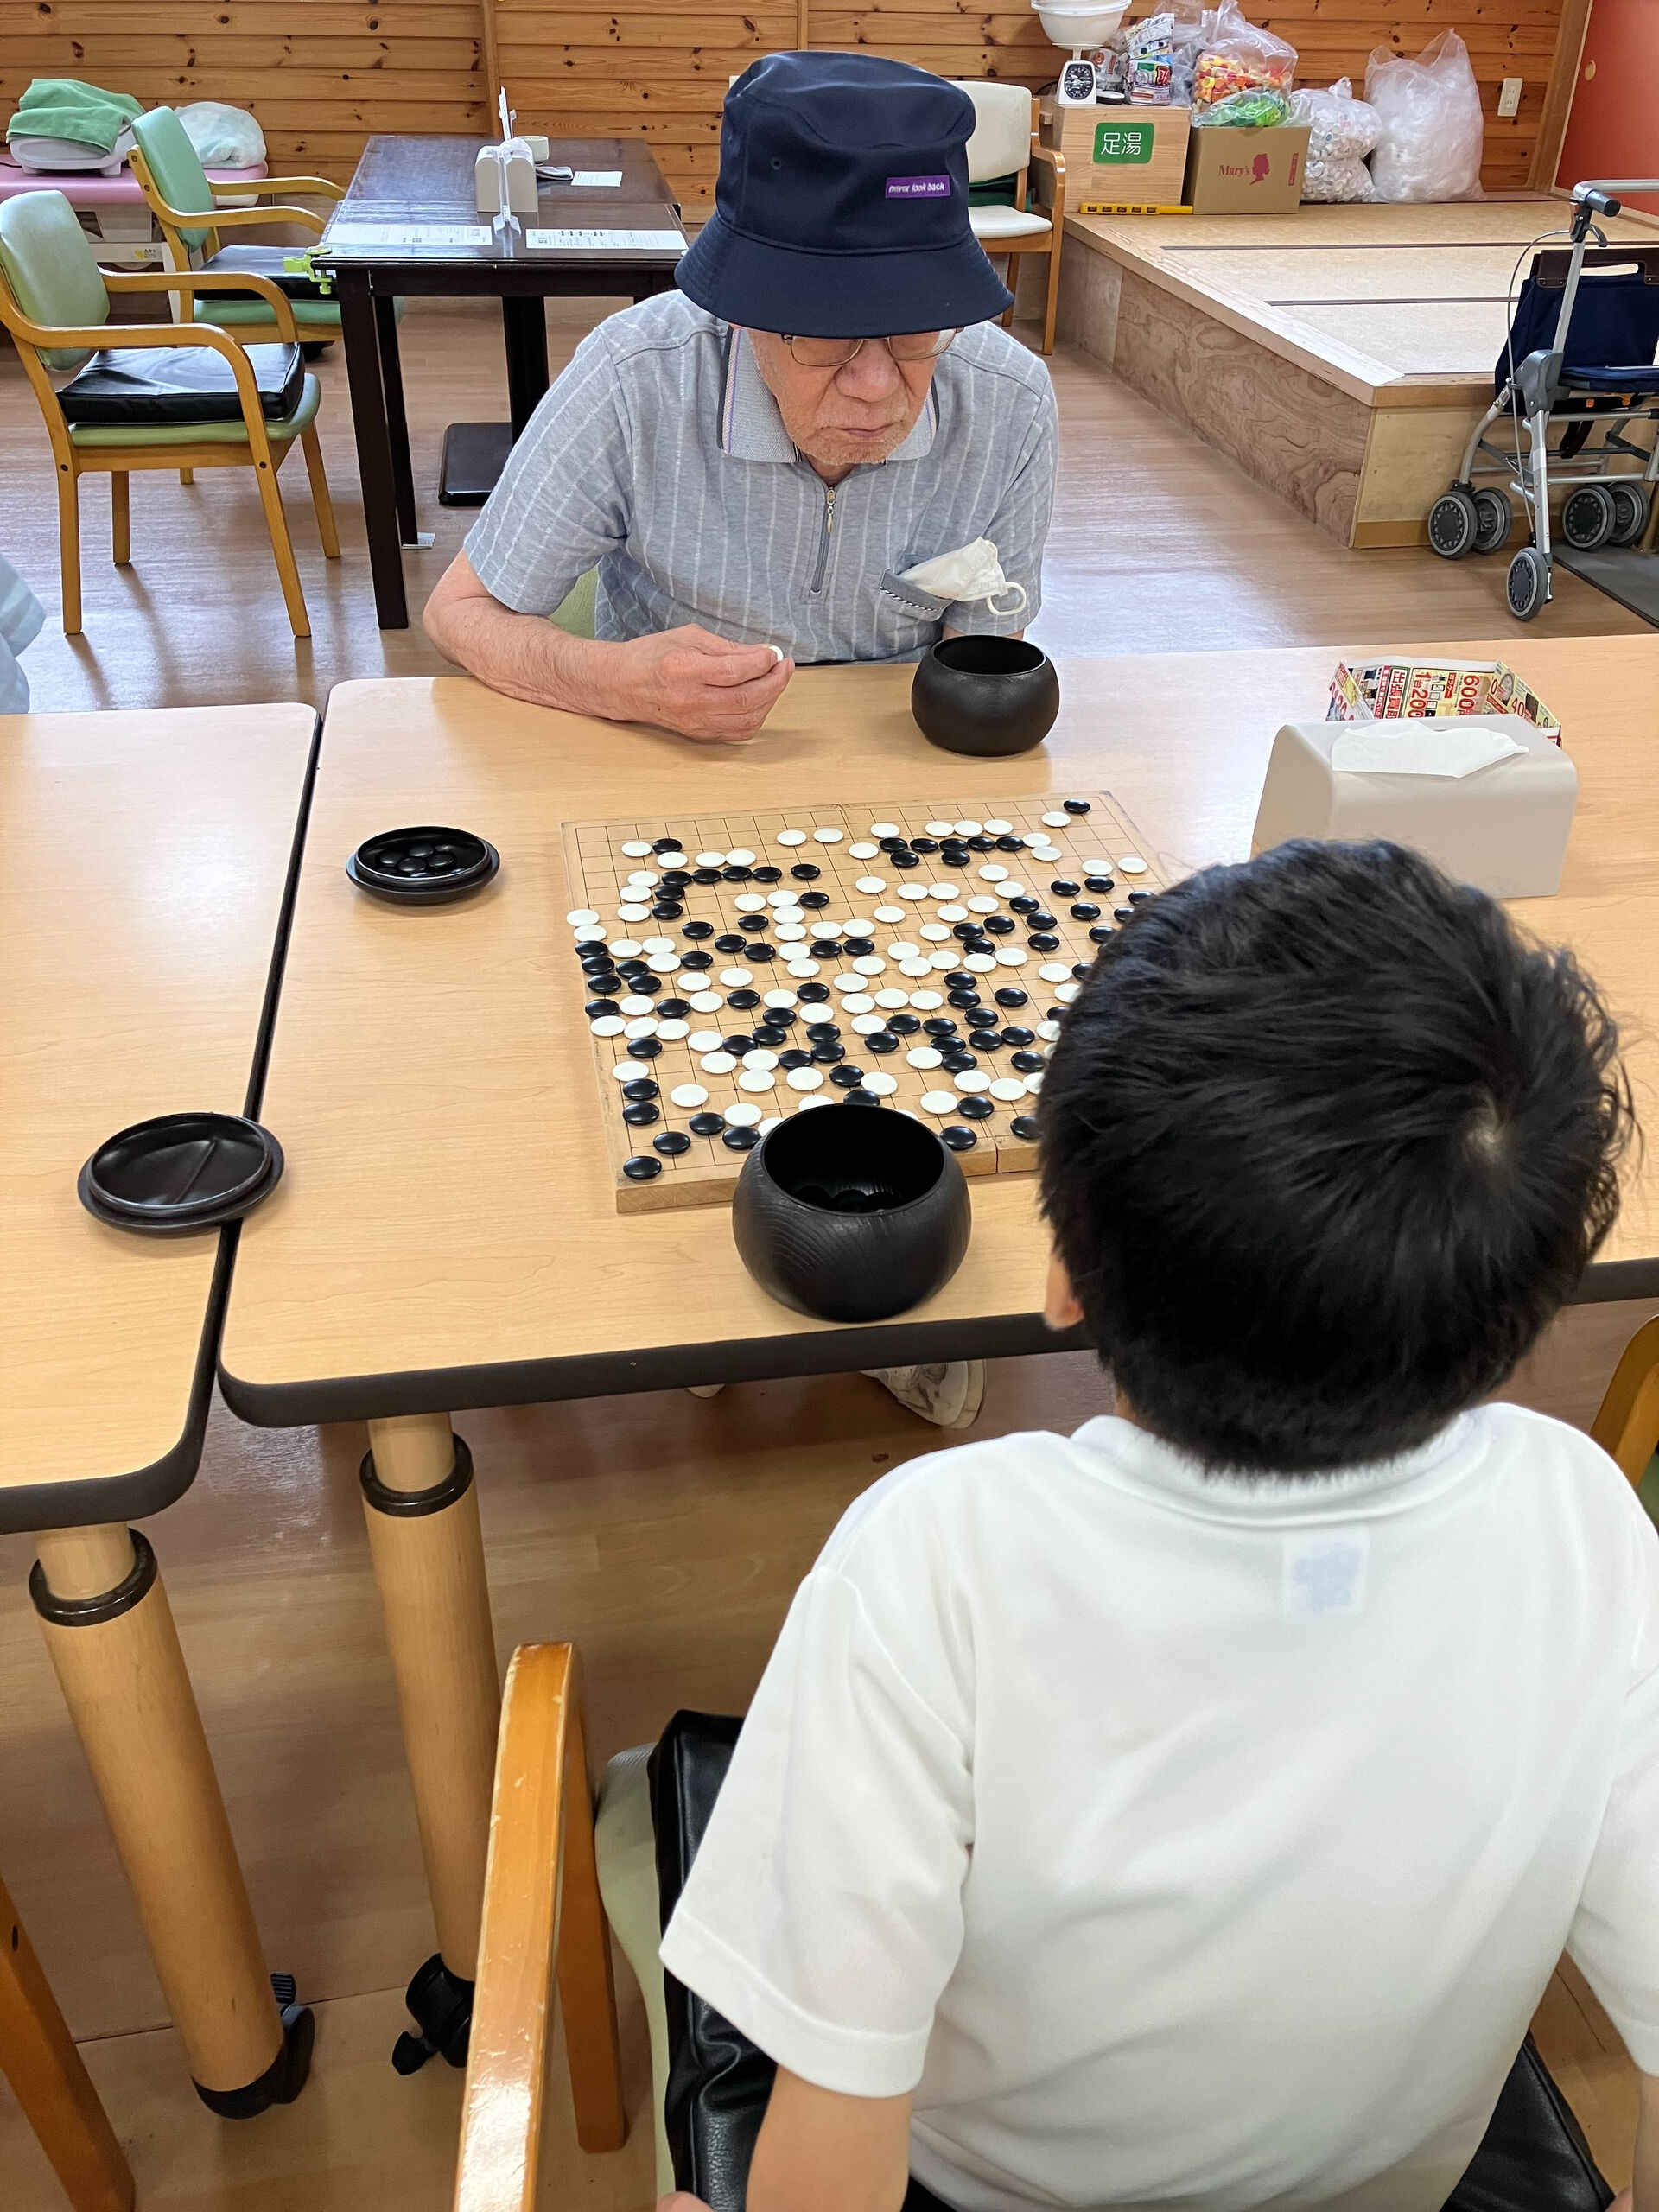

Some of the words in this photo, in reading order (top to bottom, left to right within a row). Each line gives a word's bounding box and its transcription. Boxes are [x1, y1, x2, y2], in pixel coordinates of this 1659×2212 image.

[1100, 131, 1142, 156] 足湯
[1218, 165, 1250, 177] Mary's
[911, 182, 926, 192] look
[927, 181, 944, 192] back
